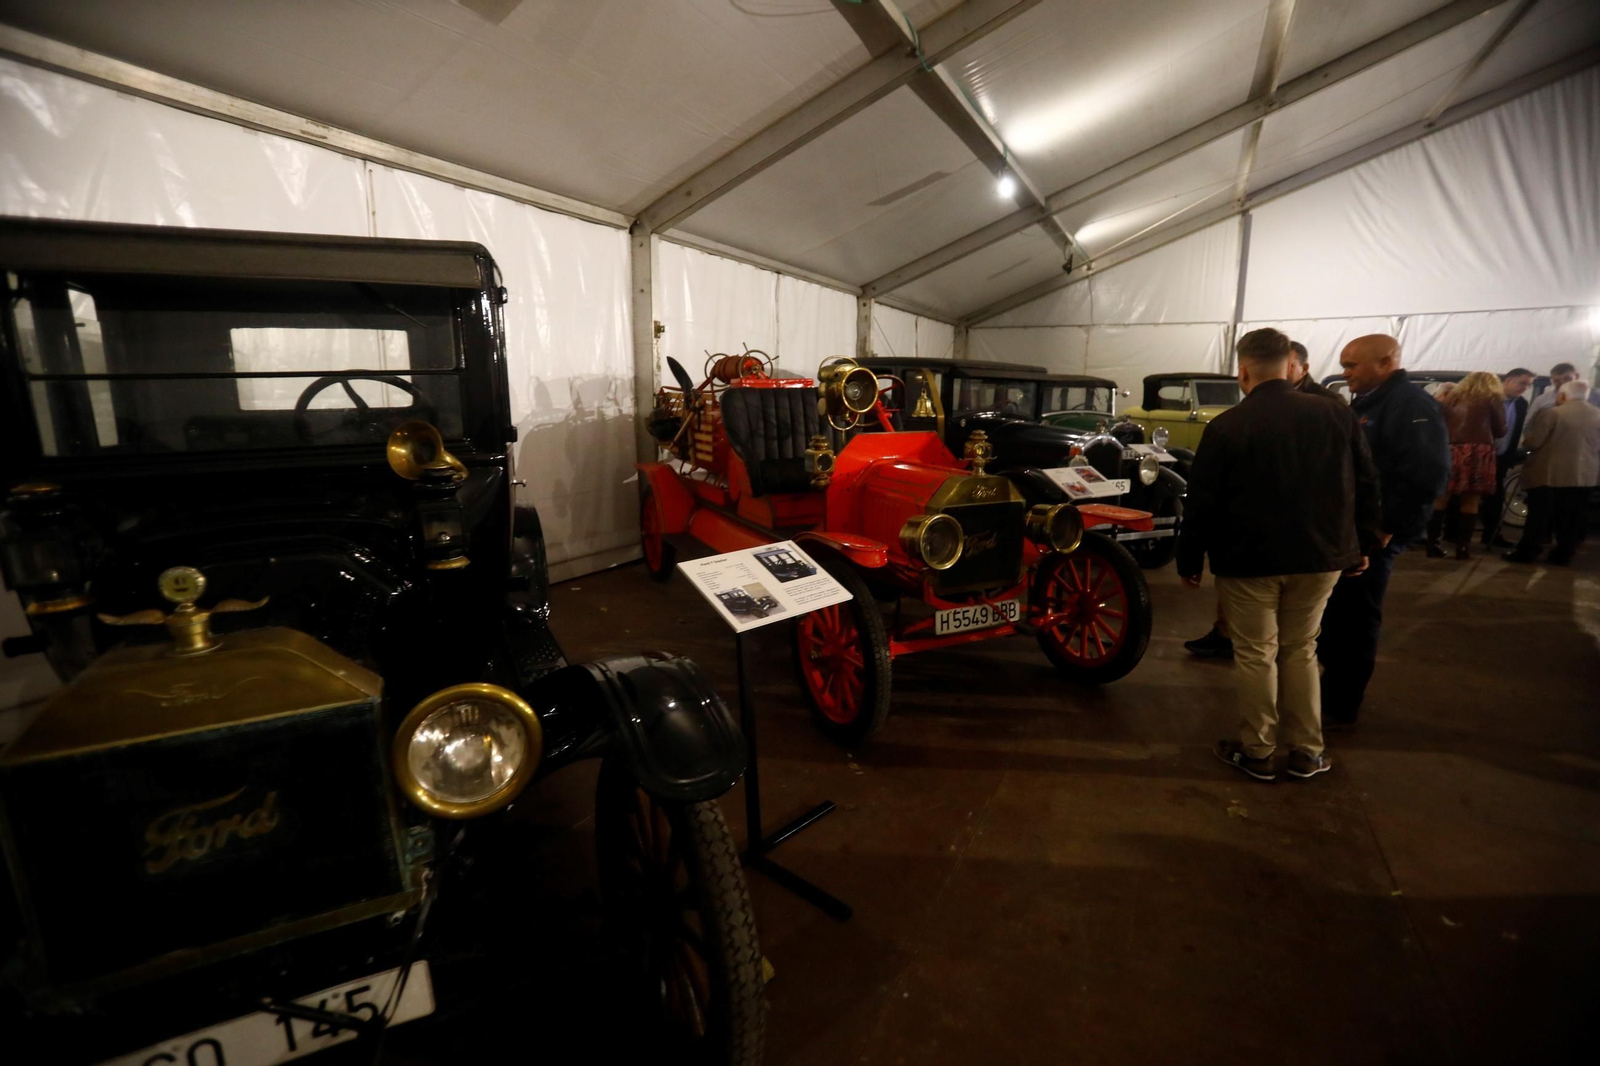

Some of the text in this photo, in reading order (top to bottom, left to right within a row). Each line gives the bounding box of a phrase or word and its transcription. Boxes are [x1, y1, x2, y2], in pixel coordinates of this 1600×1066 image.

[971, 484, 998, 499] Ford
[941, 602, 1017, 631] H 5549 BBB
[144, 786, 280, 874] Ford
